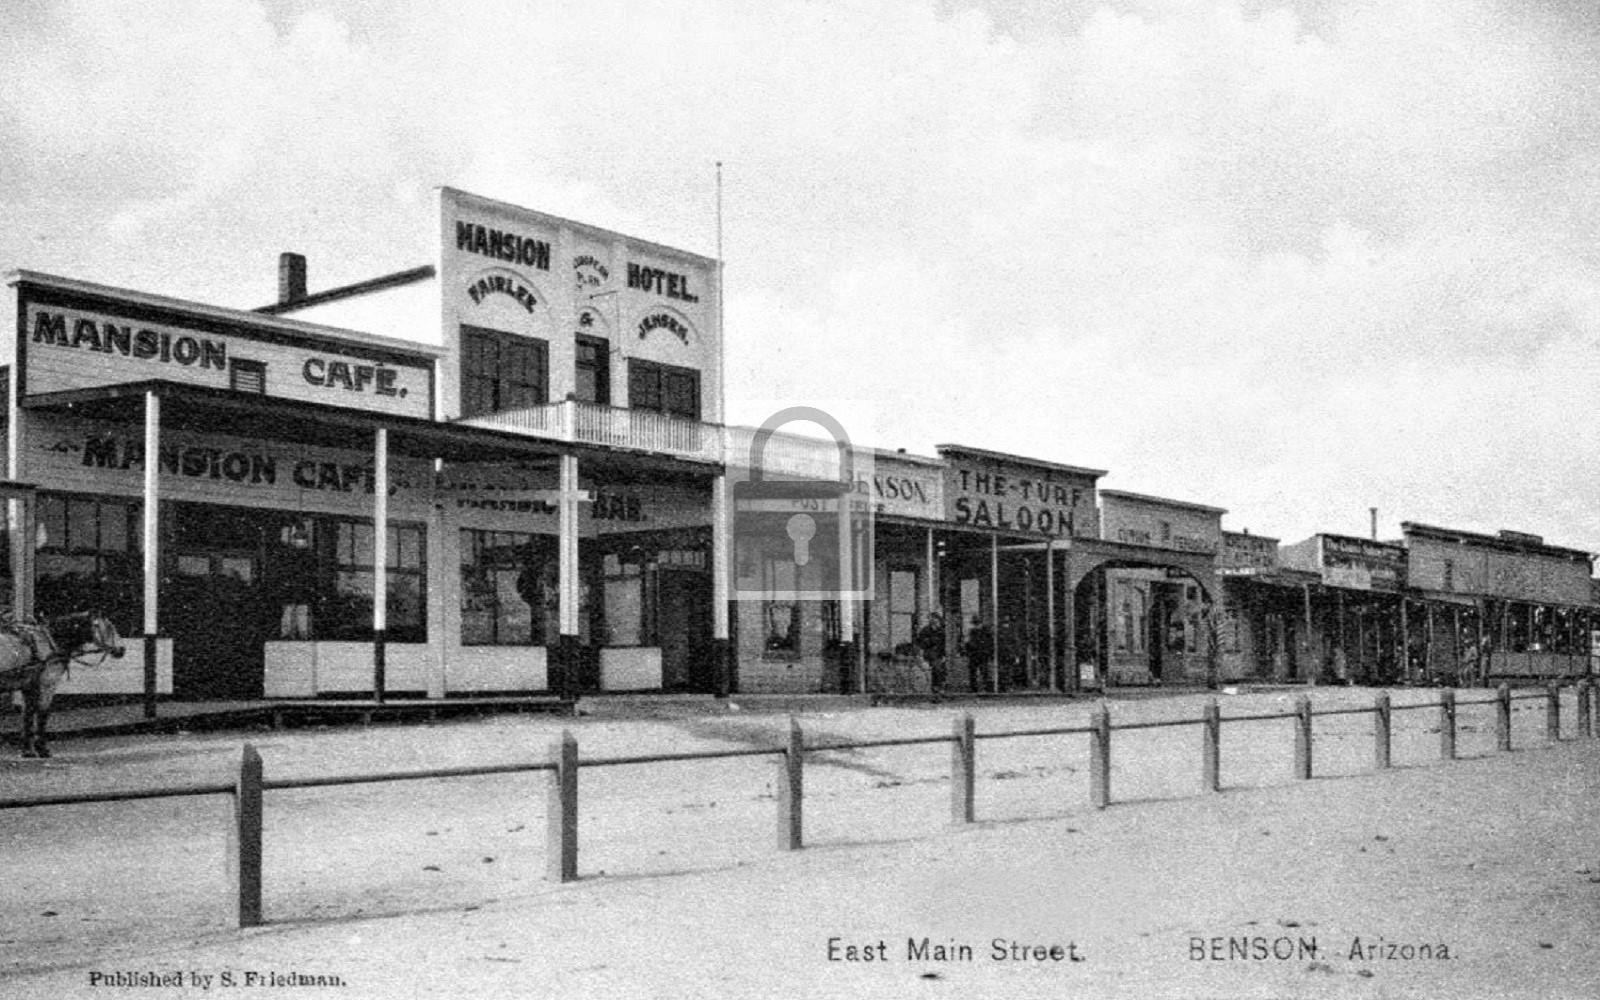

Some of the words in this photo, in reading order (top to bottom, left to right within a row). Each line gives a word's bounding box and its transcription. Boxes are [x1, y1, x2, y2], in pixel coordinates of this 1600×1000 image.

[456, 220, 551, 272] MANSION
[627, 261, 699, 303] HOTEL.
[33, 311, 227, 371] MANSION
[580, 312, 595, 328] &
[956, 497, 1074, 538] SALOON
